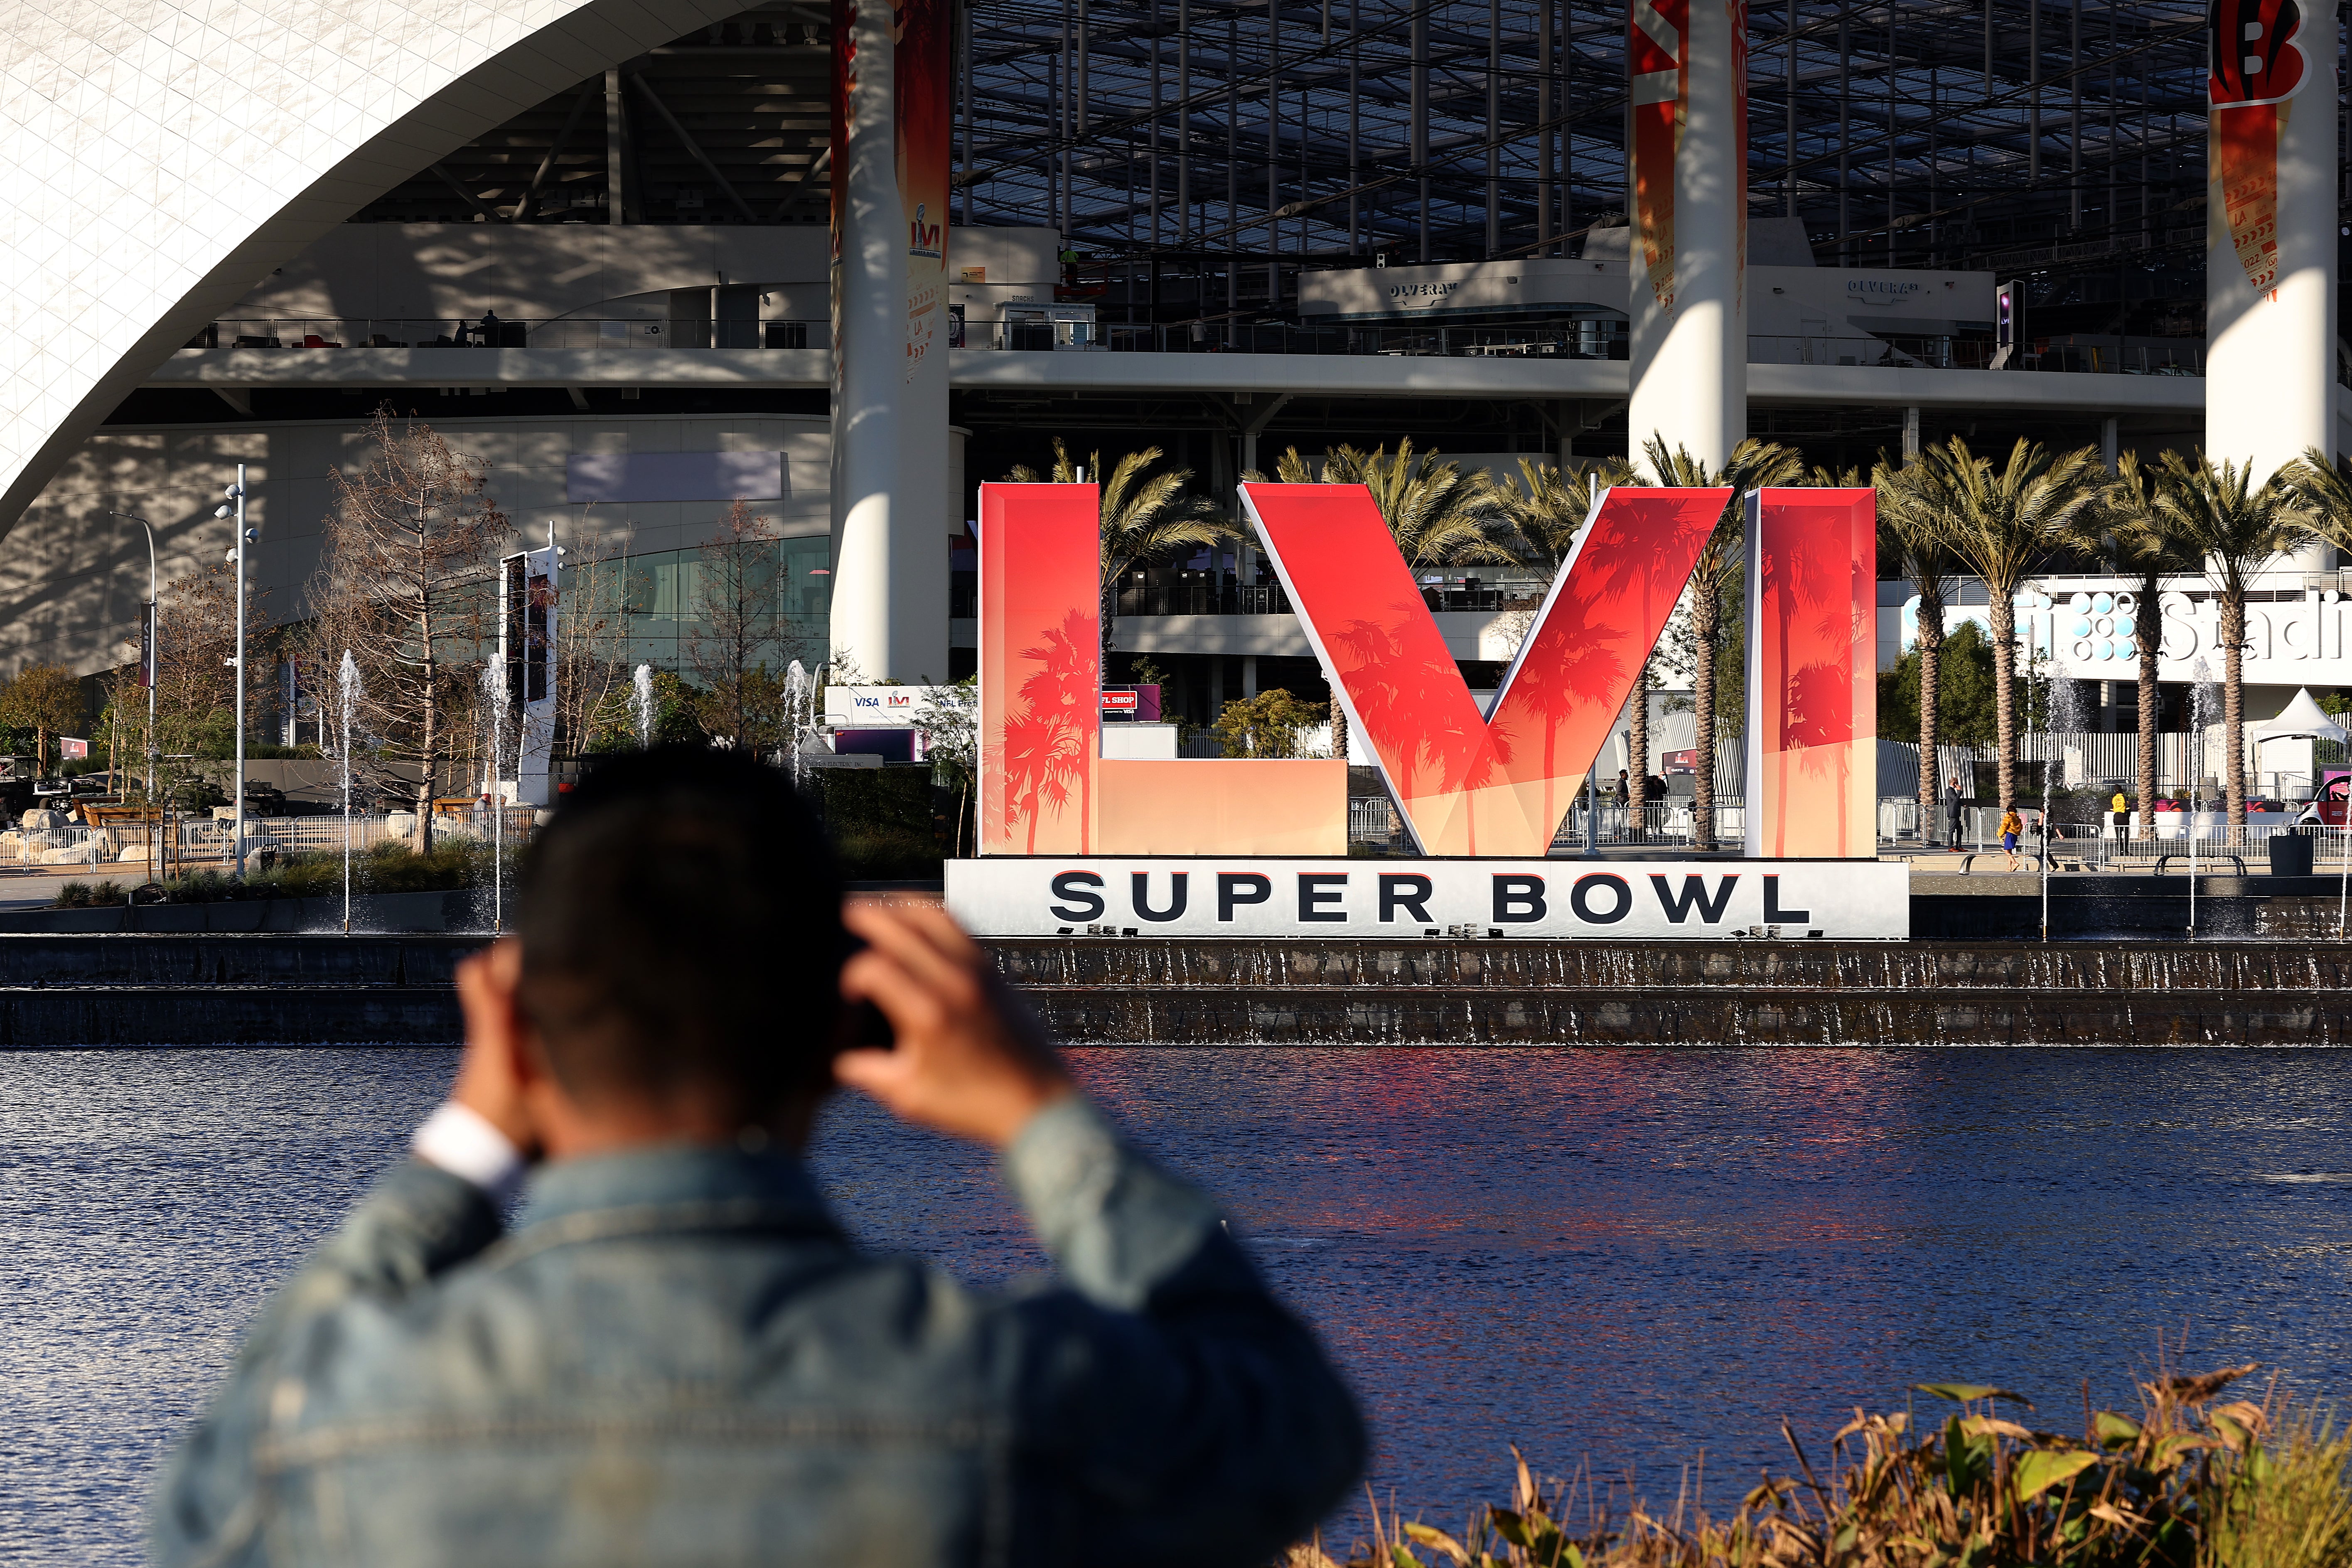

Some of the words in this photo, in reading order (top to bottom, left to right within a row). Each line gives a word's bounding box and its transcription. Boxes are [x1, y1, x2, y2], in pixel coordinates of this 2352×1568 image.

[2235, 211, 2246, 227] LA
[2241, 253, 2261, 268] 022
[1390, 283, 1448, 297] OLVERA
[1848, 280, 1909, 294] OLVERA
[2158, 589, 2352, 661] Stadi
[853, 698, 879, 707] VISA
[1049, 870, 1434, 922] SUPER
[1492, 872, 1810, 924] BOWL
